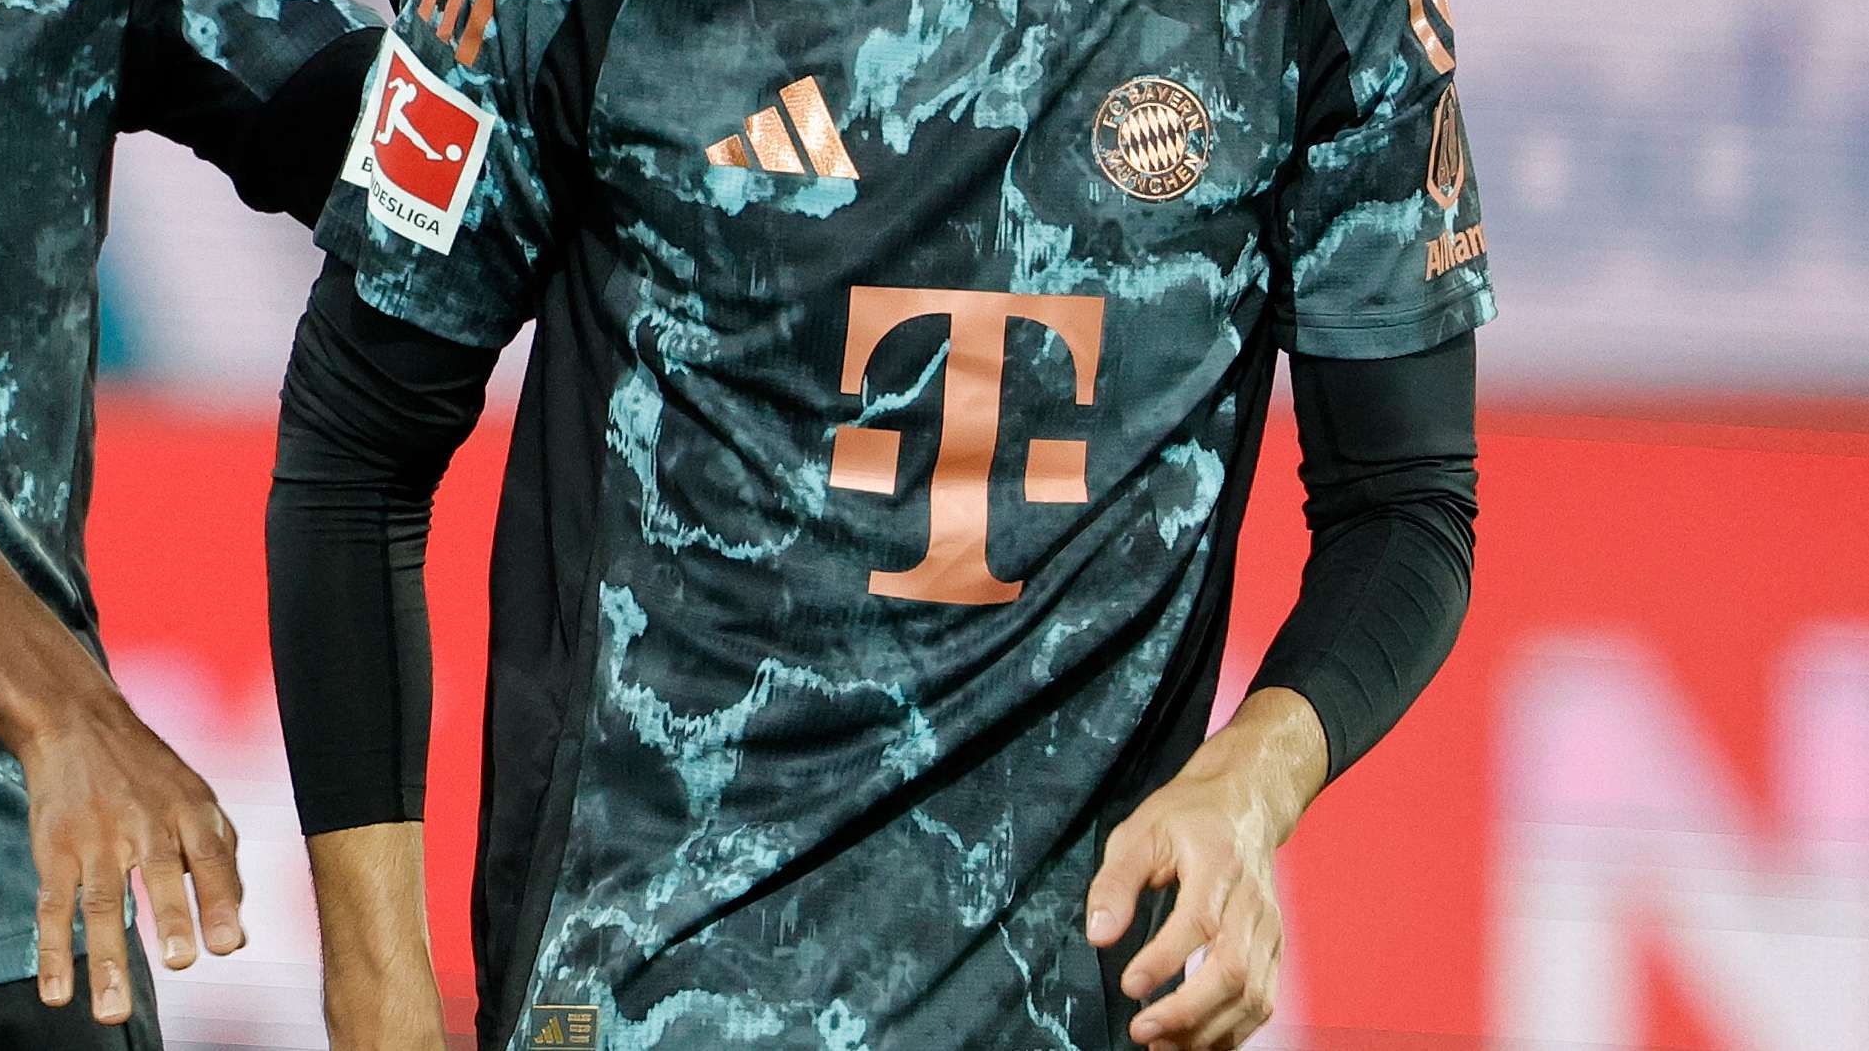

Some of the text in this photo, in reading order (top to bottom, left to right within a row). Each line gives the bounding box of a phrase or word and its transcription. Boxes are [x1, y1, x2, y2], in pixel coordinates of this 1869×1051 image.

[1128, 83, 1203, 131] BAYERN
[361, 156, 440, 236] BDESLIGA
[1425, 224, 1486, 282] Allian
